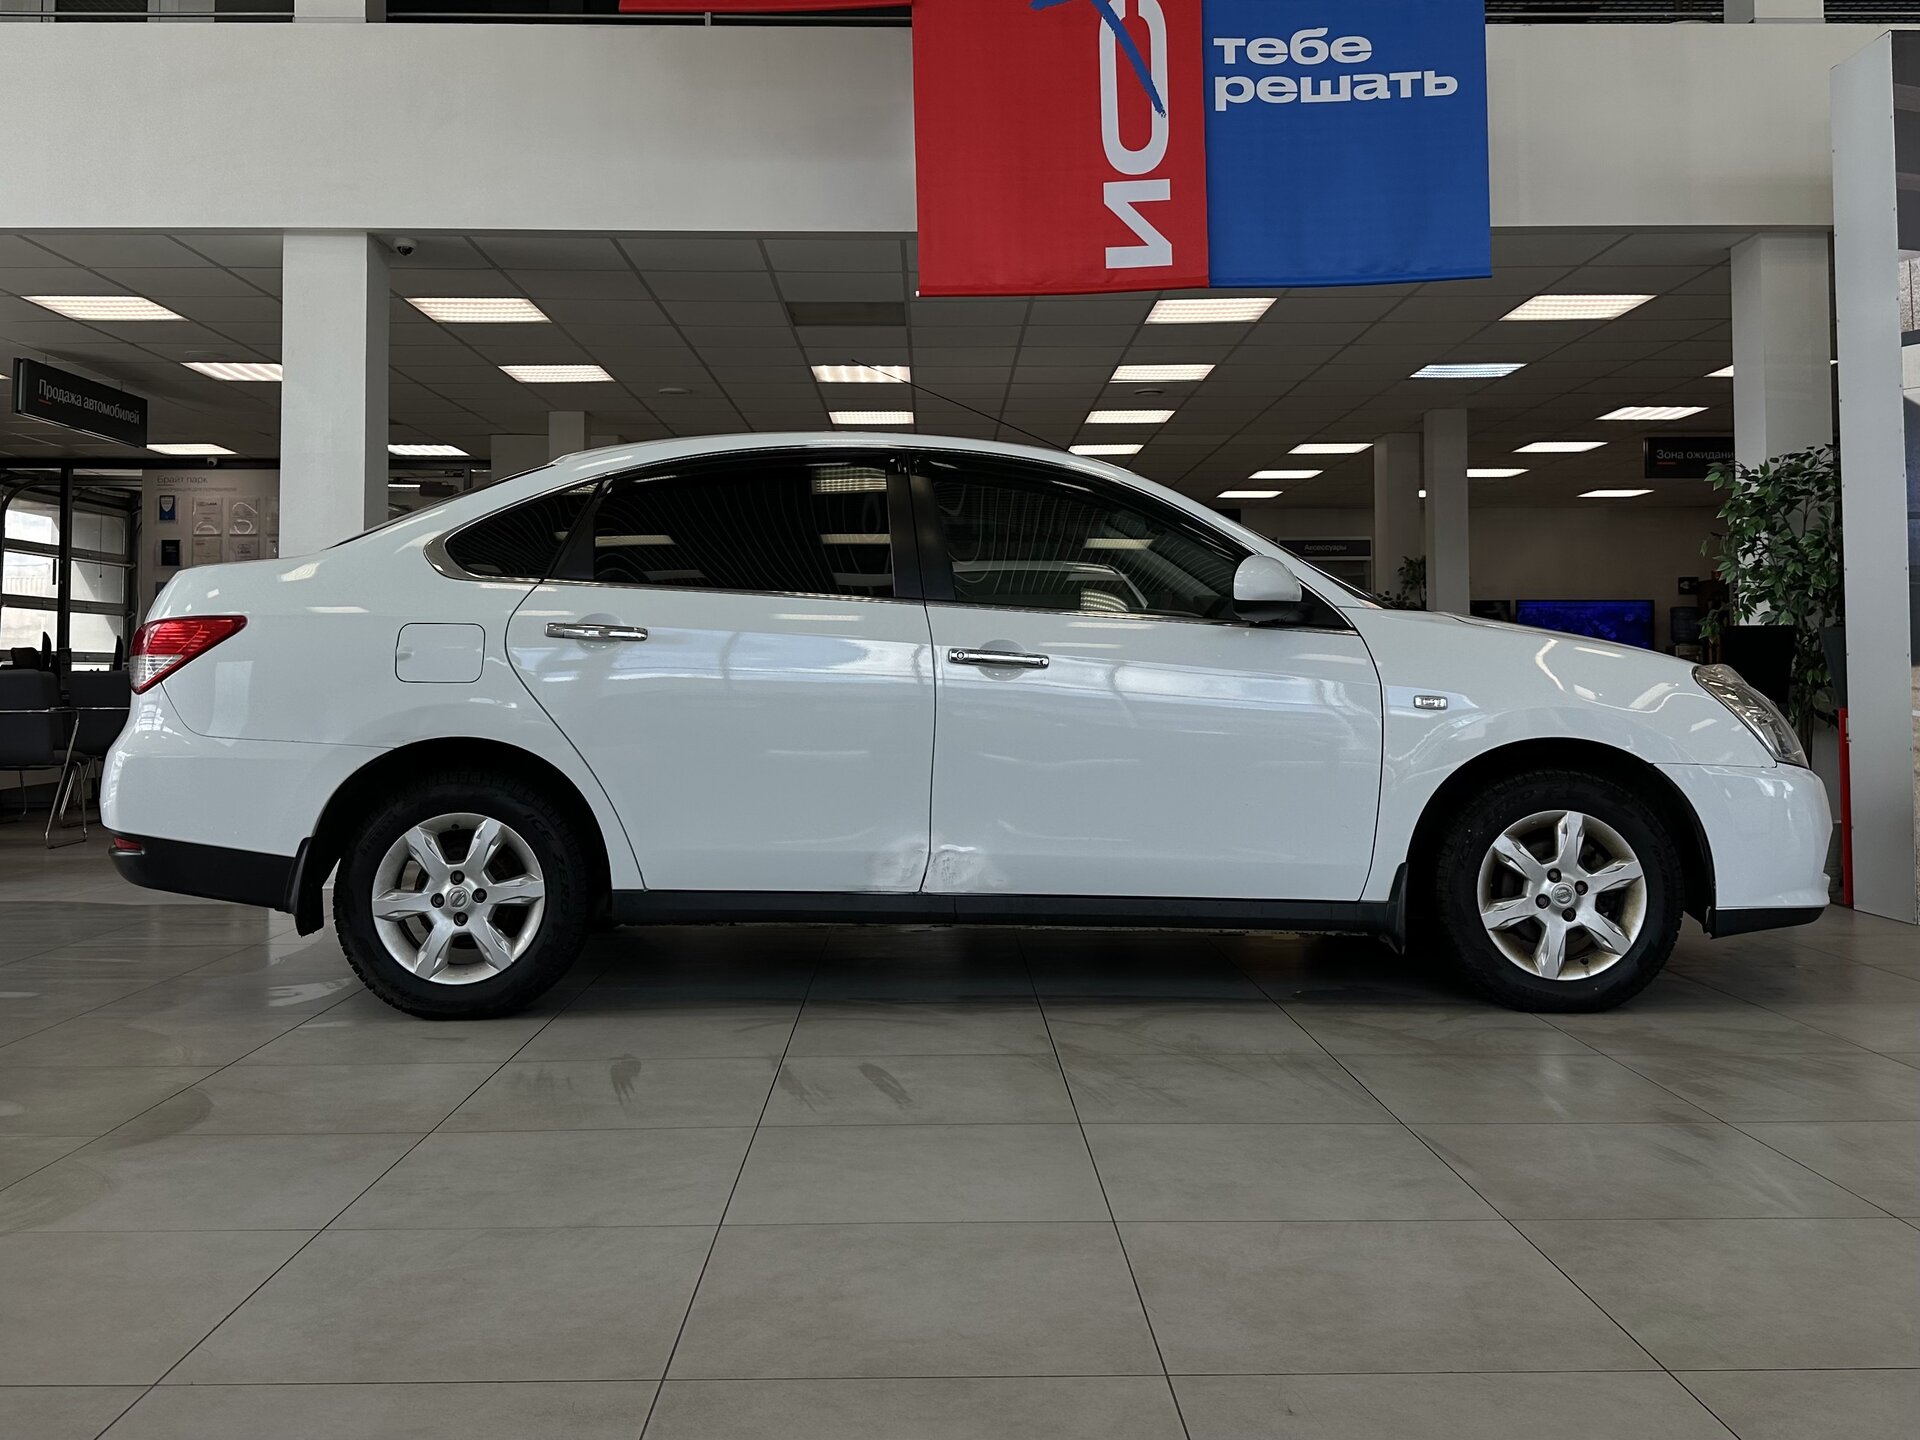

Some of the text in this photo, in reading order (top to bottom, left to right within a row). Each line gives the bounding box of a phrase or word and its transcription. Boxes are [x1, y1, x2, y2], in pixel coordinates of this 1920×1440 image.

[1213, 27, 1373, 66] тебе
[1213, 70, 1458, 112] решать
[39, 379, 140, 425] Продажа автомобилей
[1656, 449, 1735, 460] Зона ожидани
[1304, 544, 1347, 552] Аксессуары
